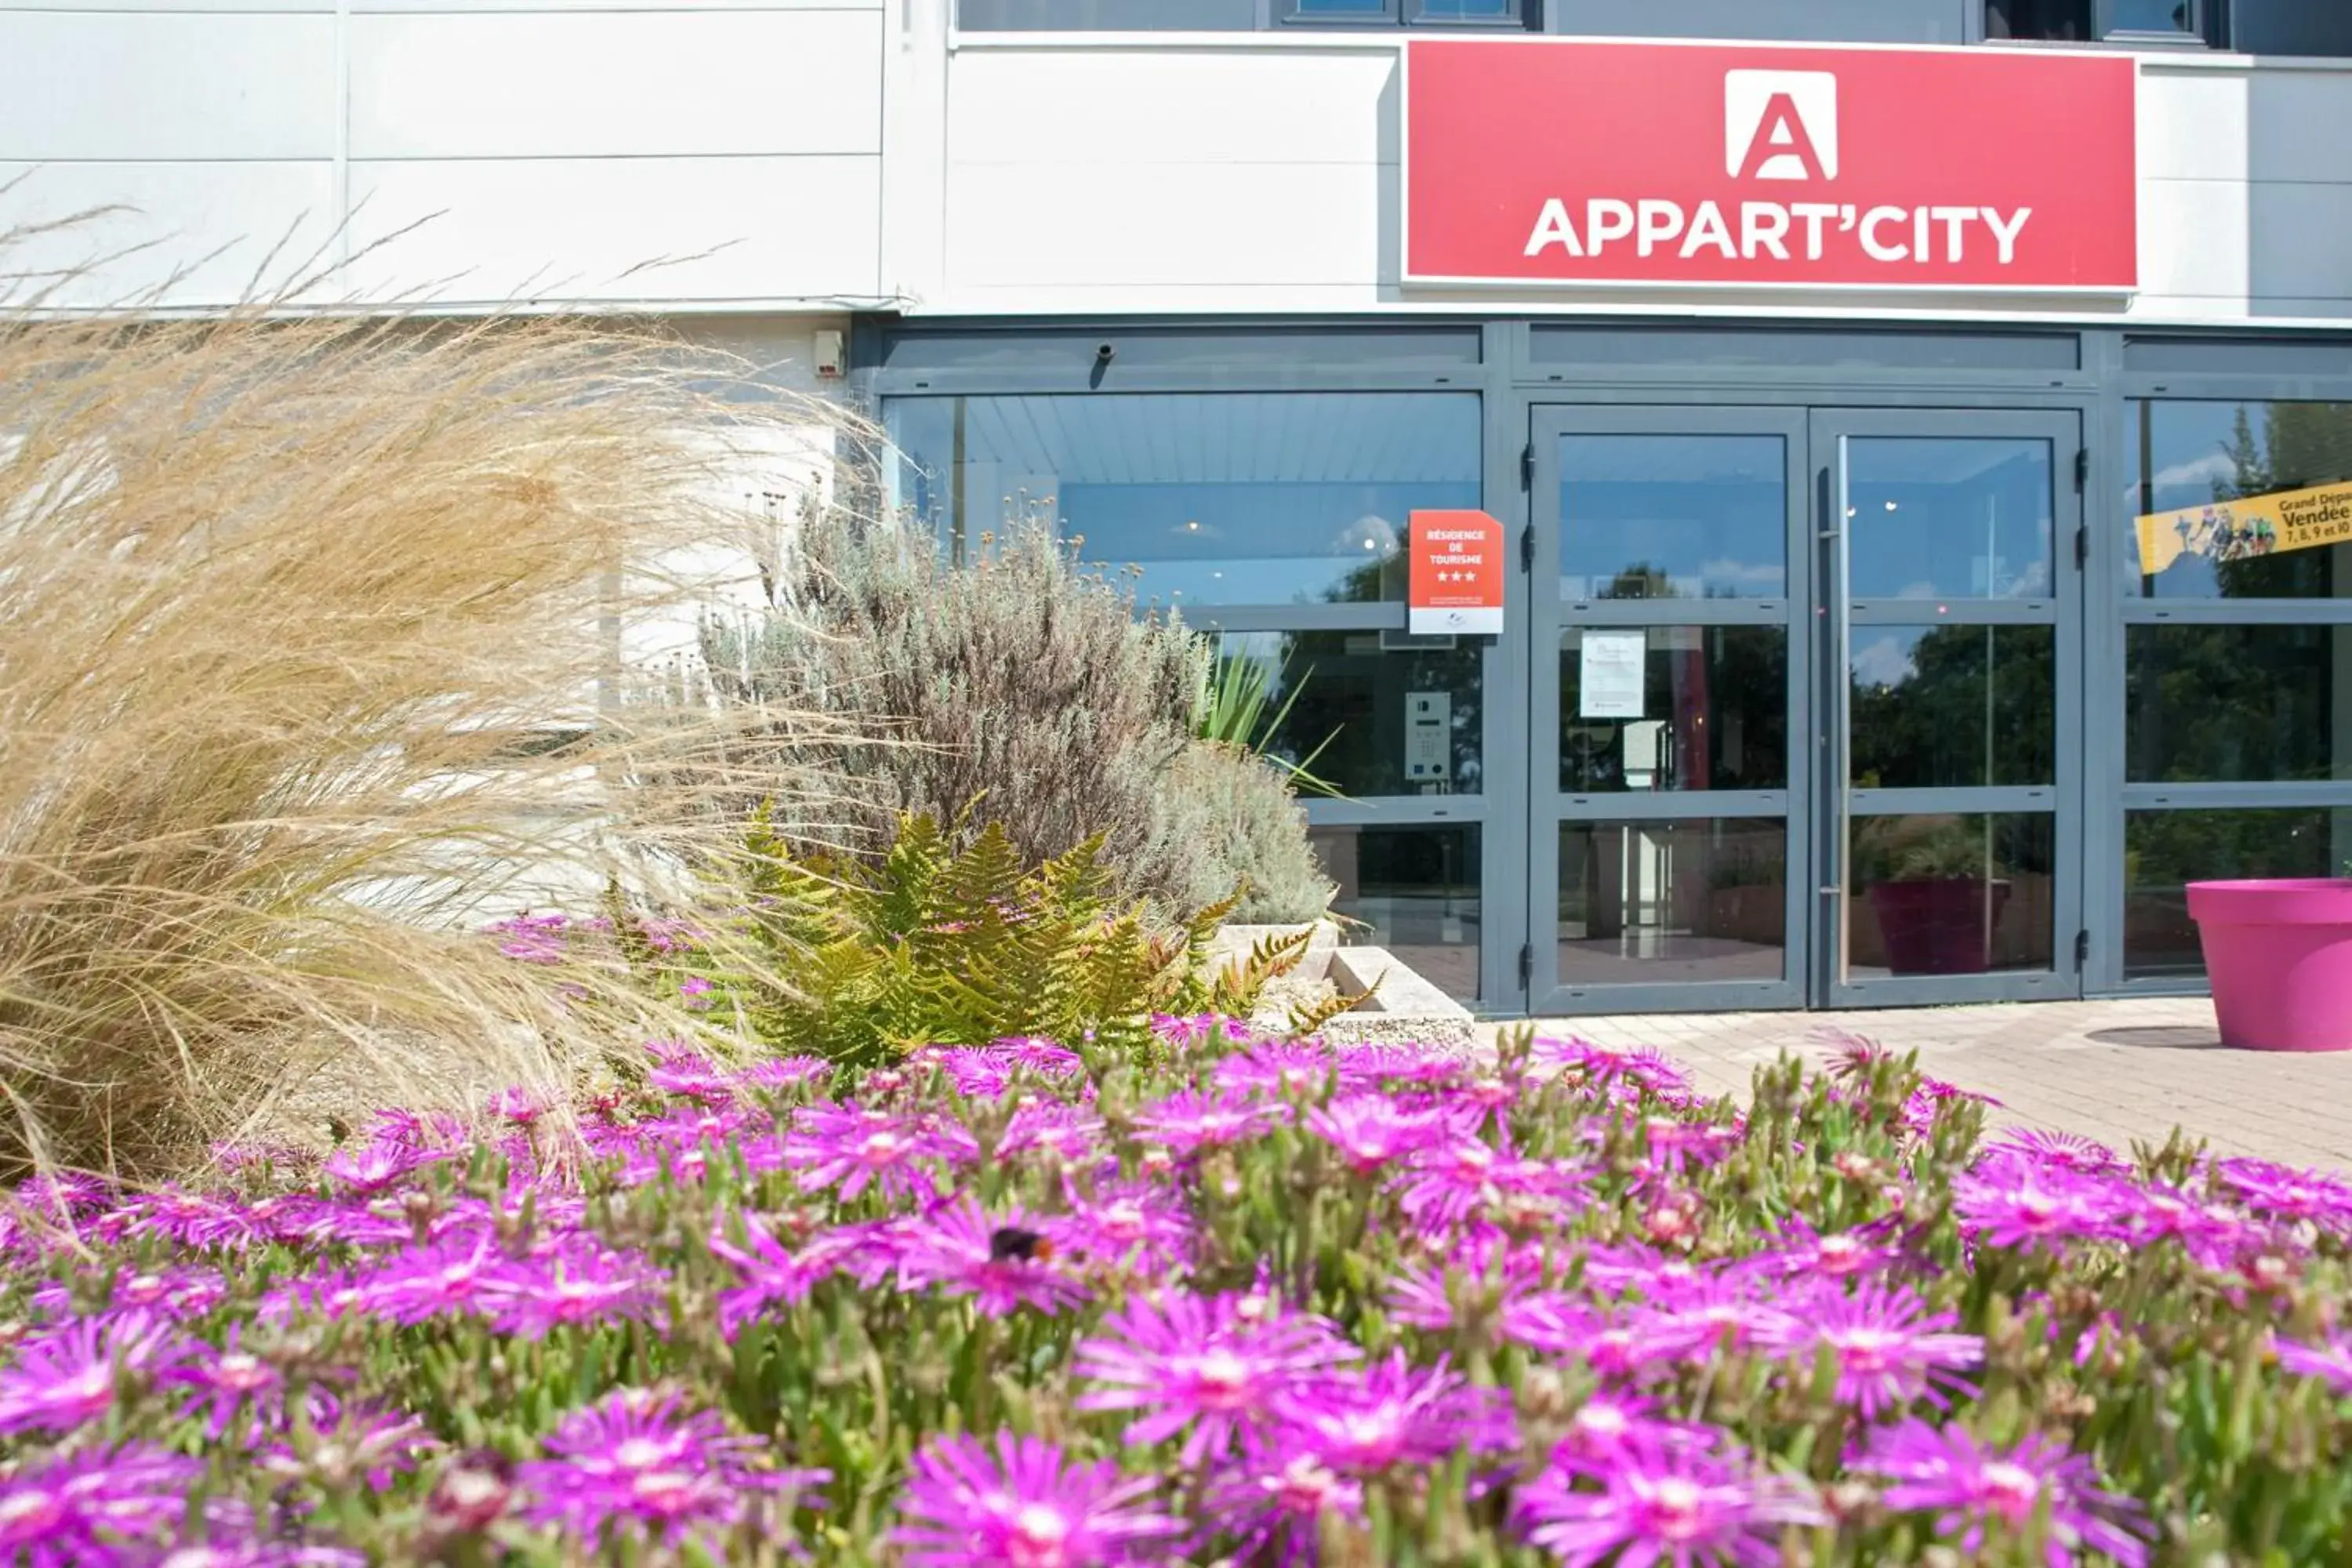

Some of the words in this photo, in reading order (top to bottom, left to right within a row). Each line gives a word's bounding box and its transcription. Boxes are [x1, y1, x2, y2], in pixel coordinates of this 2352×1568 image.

[1734, 89, 1831, 180] A
[1523, 198, 2032, 264] APPART'CITY
[2278, 495, 2316, 511] Grand
[1426, 528, 1486, 540] RÉSIDENCE
[2313, 525, 2321, 539] 9
[2324, 526, 2336, 536] et
[2337, 521, 2350, 534] 10
[1448, 543, 1463, 553] DE
[1429, 555, 1482, 565] TOURISME
